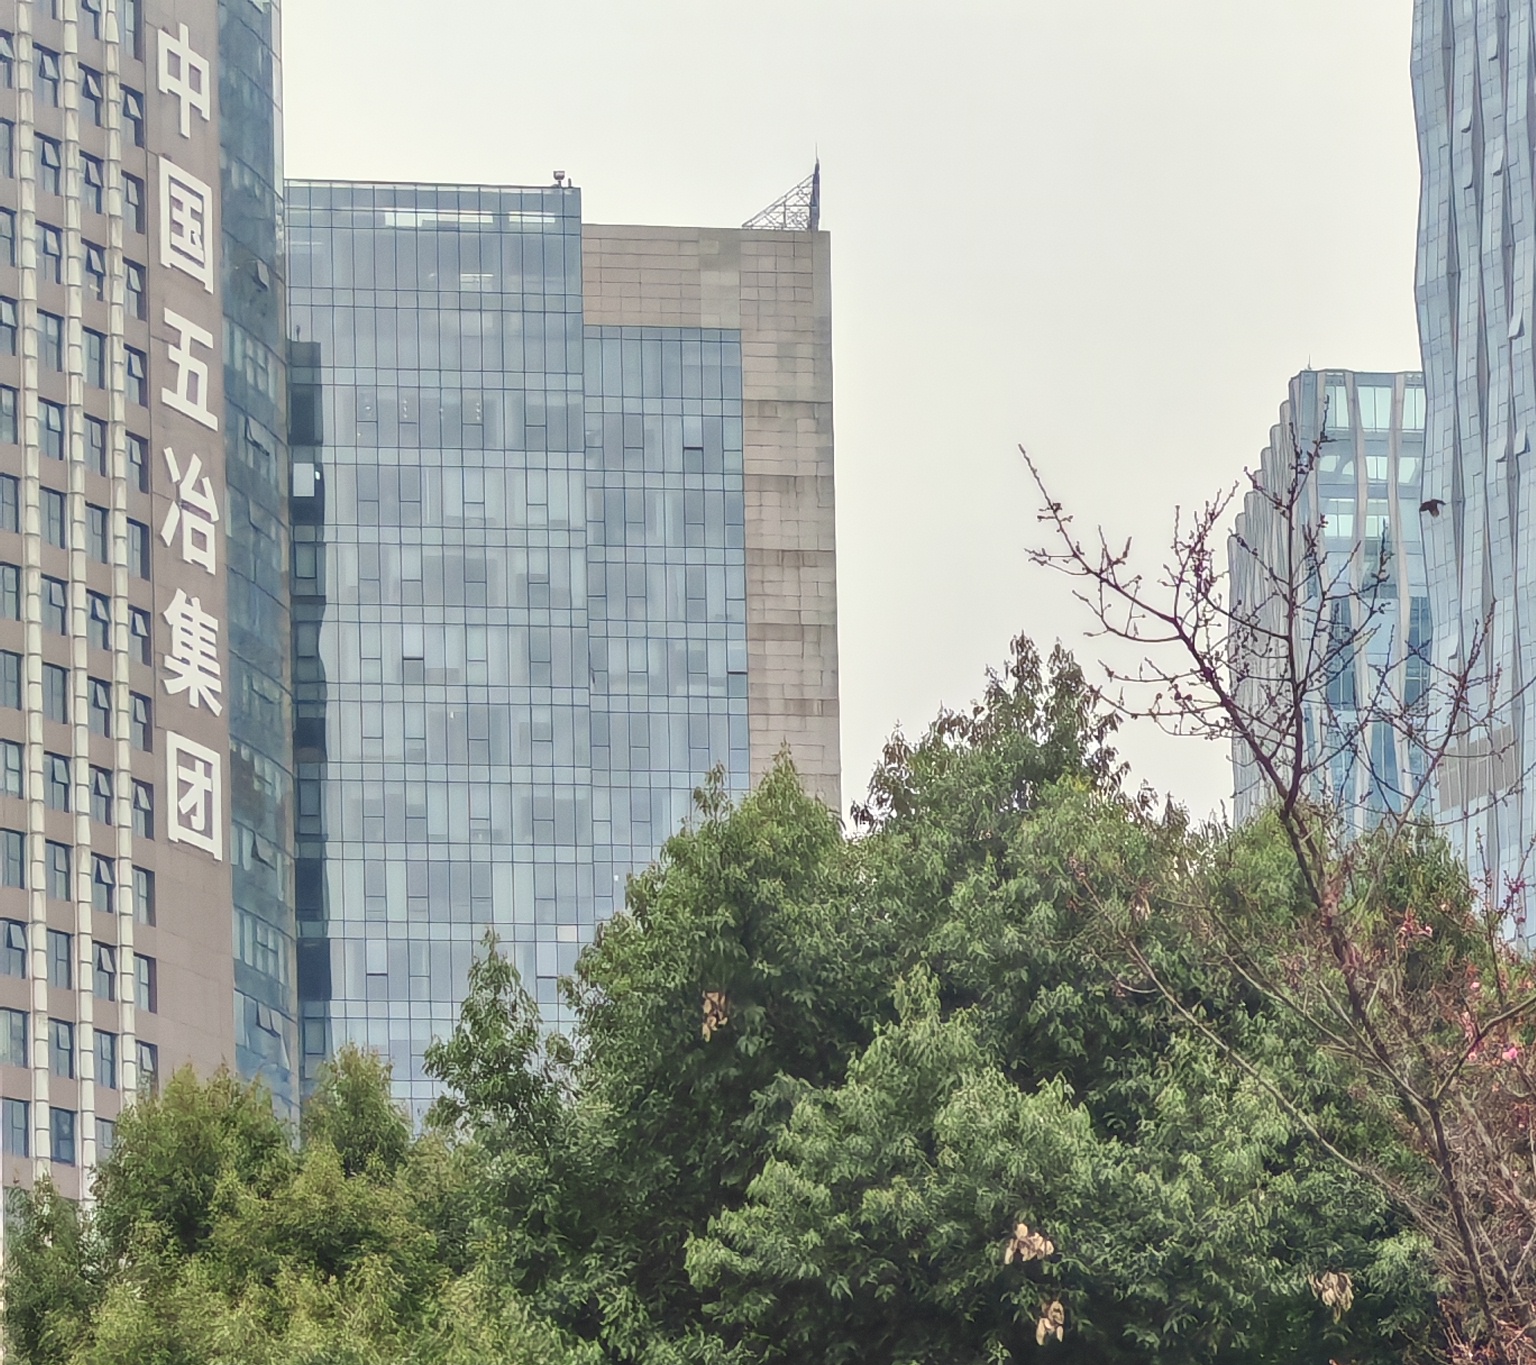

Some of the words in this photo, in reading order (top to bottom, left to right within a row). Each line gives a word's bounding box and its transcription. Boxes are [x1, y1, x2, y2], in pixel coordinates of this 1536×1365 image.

[157, 22, 224, 862] 中国五冶集团
